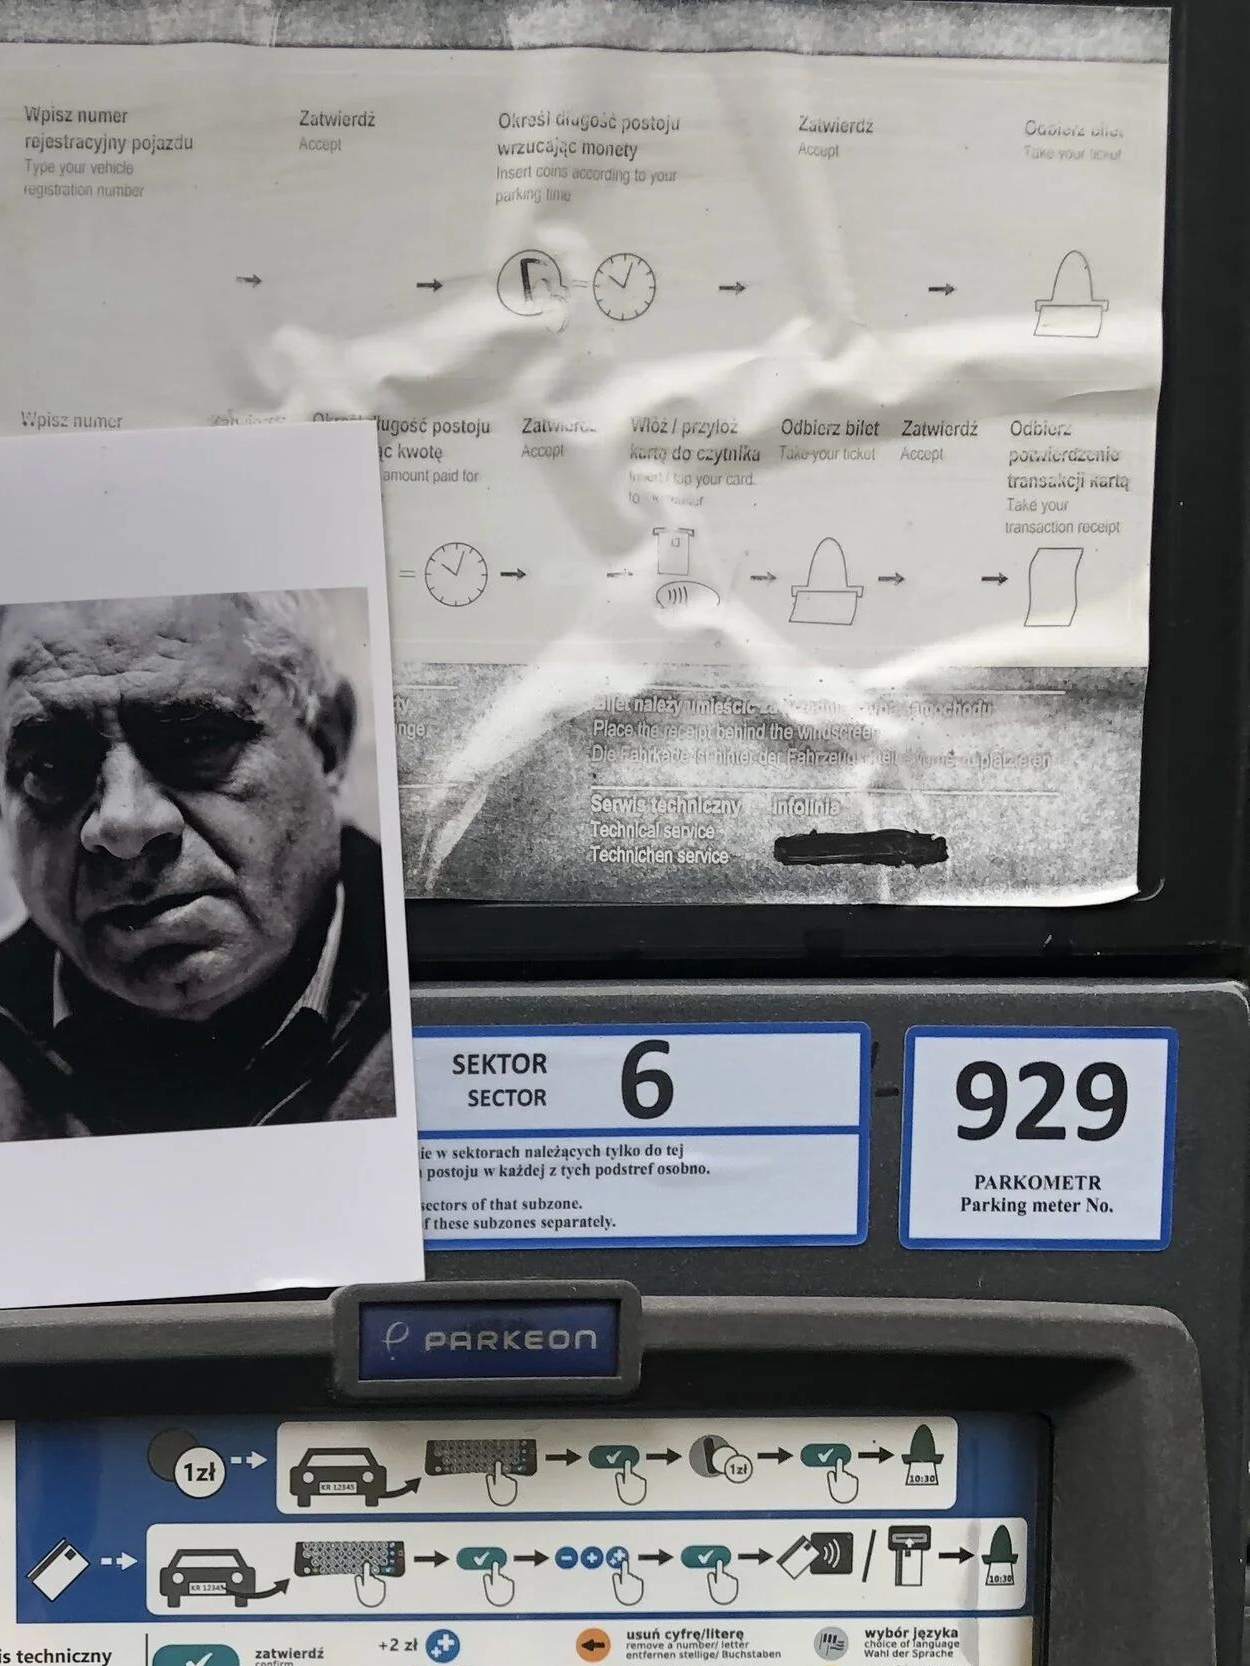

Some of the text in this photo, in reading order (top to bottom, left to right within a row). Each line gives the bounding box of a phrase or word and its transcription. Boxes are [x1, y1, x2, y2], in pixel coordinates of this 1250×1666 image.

[24, 106, 127, 128] Wpisz numer
[25, 134, 194, 154] rejestracyjny pojazdu
[582, 140, 638, 161] monety
[432, 418, 491, 437] postoju
[781, 418, 880, 437] Odbierz bilet
[397, 444, 443, 463] kwotę
[591, 794, 646, 814] Serwis
[452, 1053, 547, 1074] SEKTOR
[621, 1039, 674, 1119] 6
[467, 1088, 547, 1106] SECTOR
[956, 1060, 1128, 1141] 929
[452, 1145, 520, 1159] sektorach
[525, 1144, 600, 1161] należących
[605, 1144, 641, 1159] tylko
[644, 1143, 662, 1157] do
[666, 1143, 684, 1159] tej
[427, 1164, 479, 1180] postoju
[499, 1163, 545, 1181] każdej
[560, 1163, 590, 1179] tych
[595, 1163, 652, 1179] podstref
[657, 1163, 710, 1175] osobno.
[974, 1175, 1102, 1191] PARKOMETR
[471, 1198, 487, 1211] of
[490, 1198, 517, 1211] that
[521, 1198, 583, 1211] subzone.
[961, 1197, 1114, 1216] Parking meter No.
[434, 1215, 616, 1230] these subzones separately.
[425, 1330, 597, 1350] PARKEON
[184, 1462, 216, 1482] 1zł
[910, 1474, 936, 1483] 10:30
[626, 1628, 660, 1640] usuń
[865, 1626, 959, 1641] wybór języka
[16, 1648, 112, 1666] techniczny
[255, 1646, 325, 1660] zatwierdź
